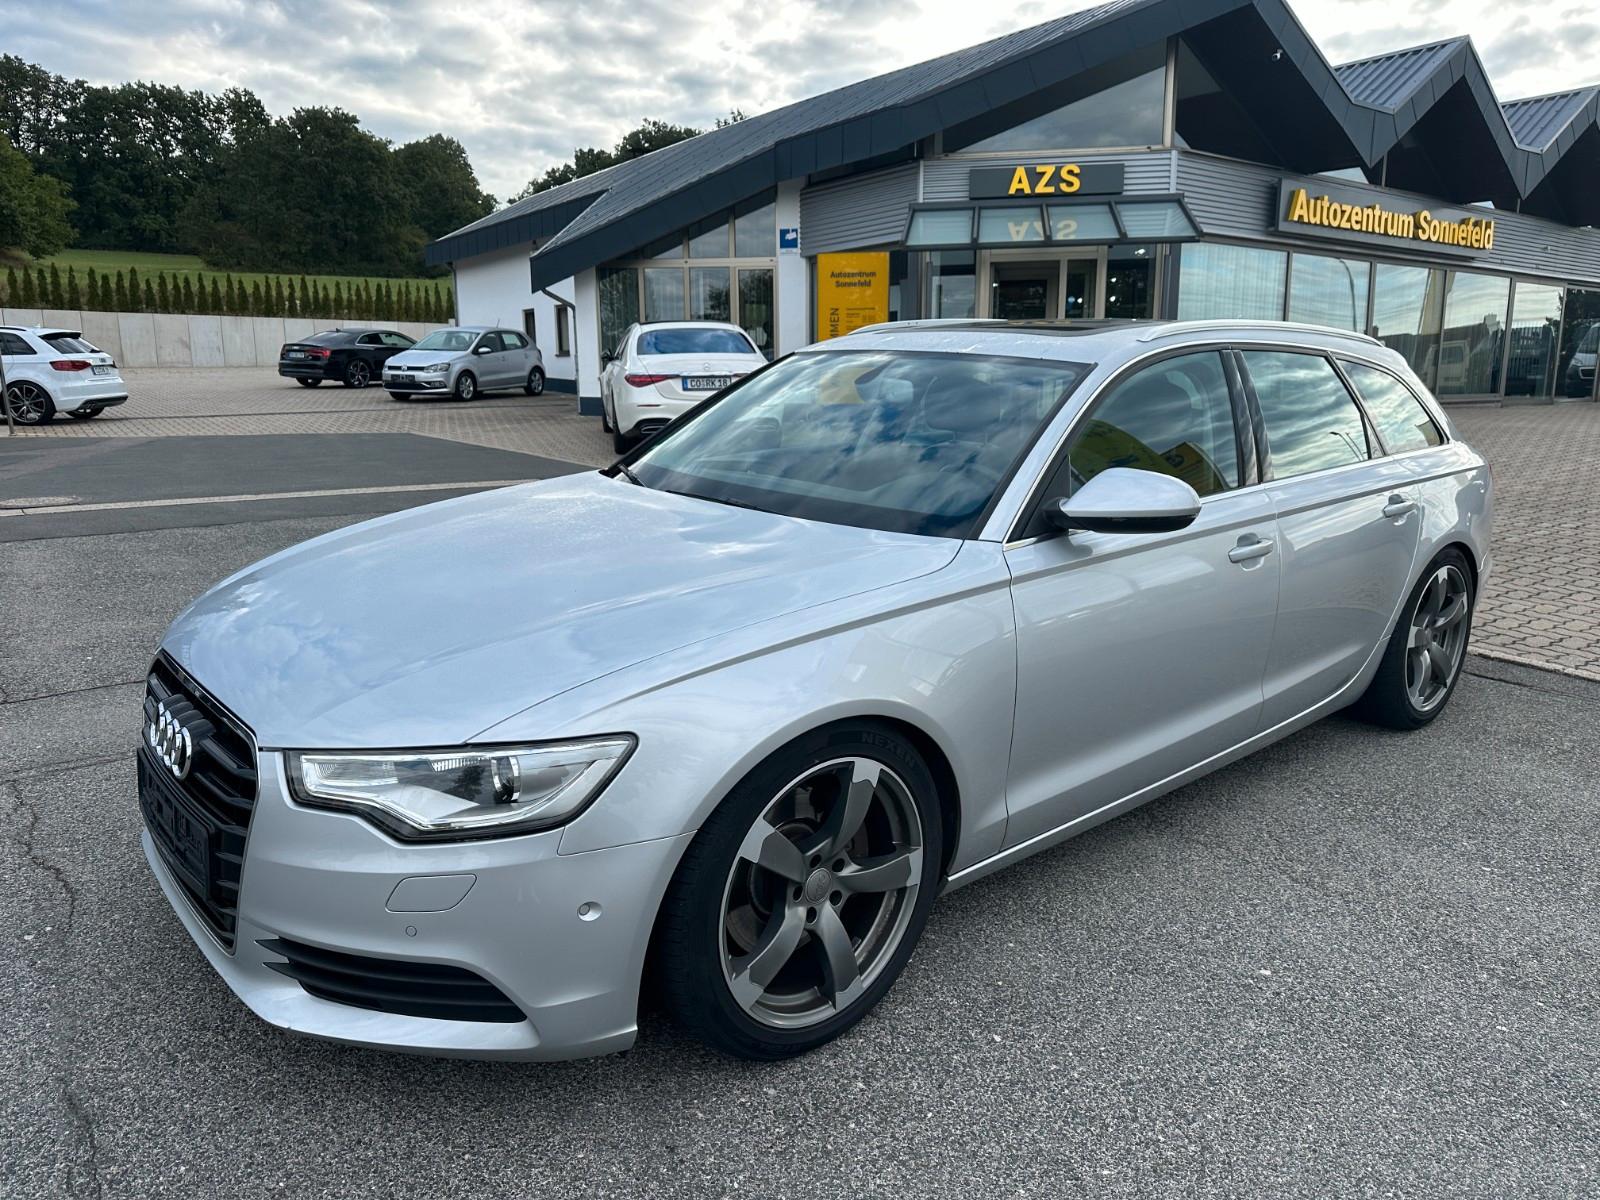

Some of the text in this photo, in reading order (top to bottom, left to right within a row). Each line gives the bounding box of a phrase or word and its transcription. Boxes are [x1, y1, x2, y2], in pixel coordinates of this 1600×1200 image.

[1008, 164, 1082, 195] AZS
[1289, 188, 1495, 250] Autozentrum Sonnefeld
[830, 271, 876, 279] Autozentrum
[835, 279, 872, 288] Sonnefeld
[862, 731, 916, 768] NEXEN
